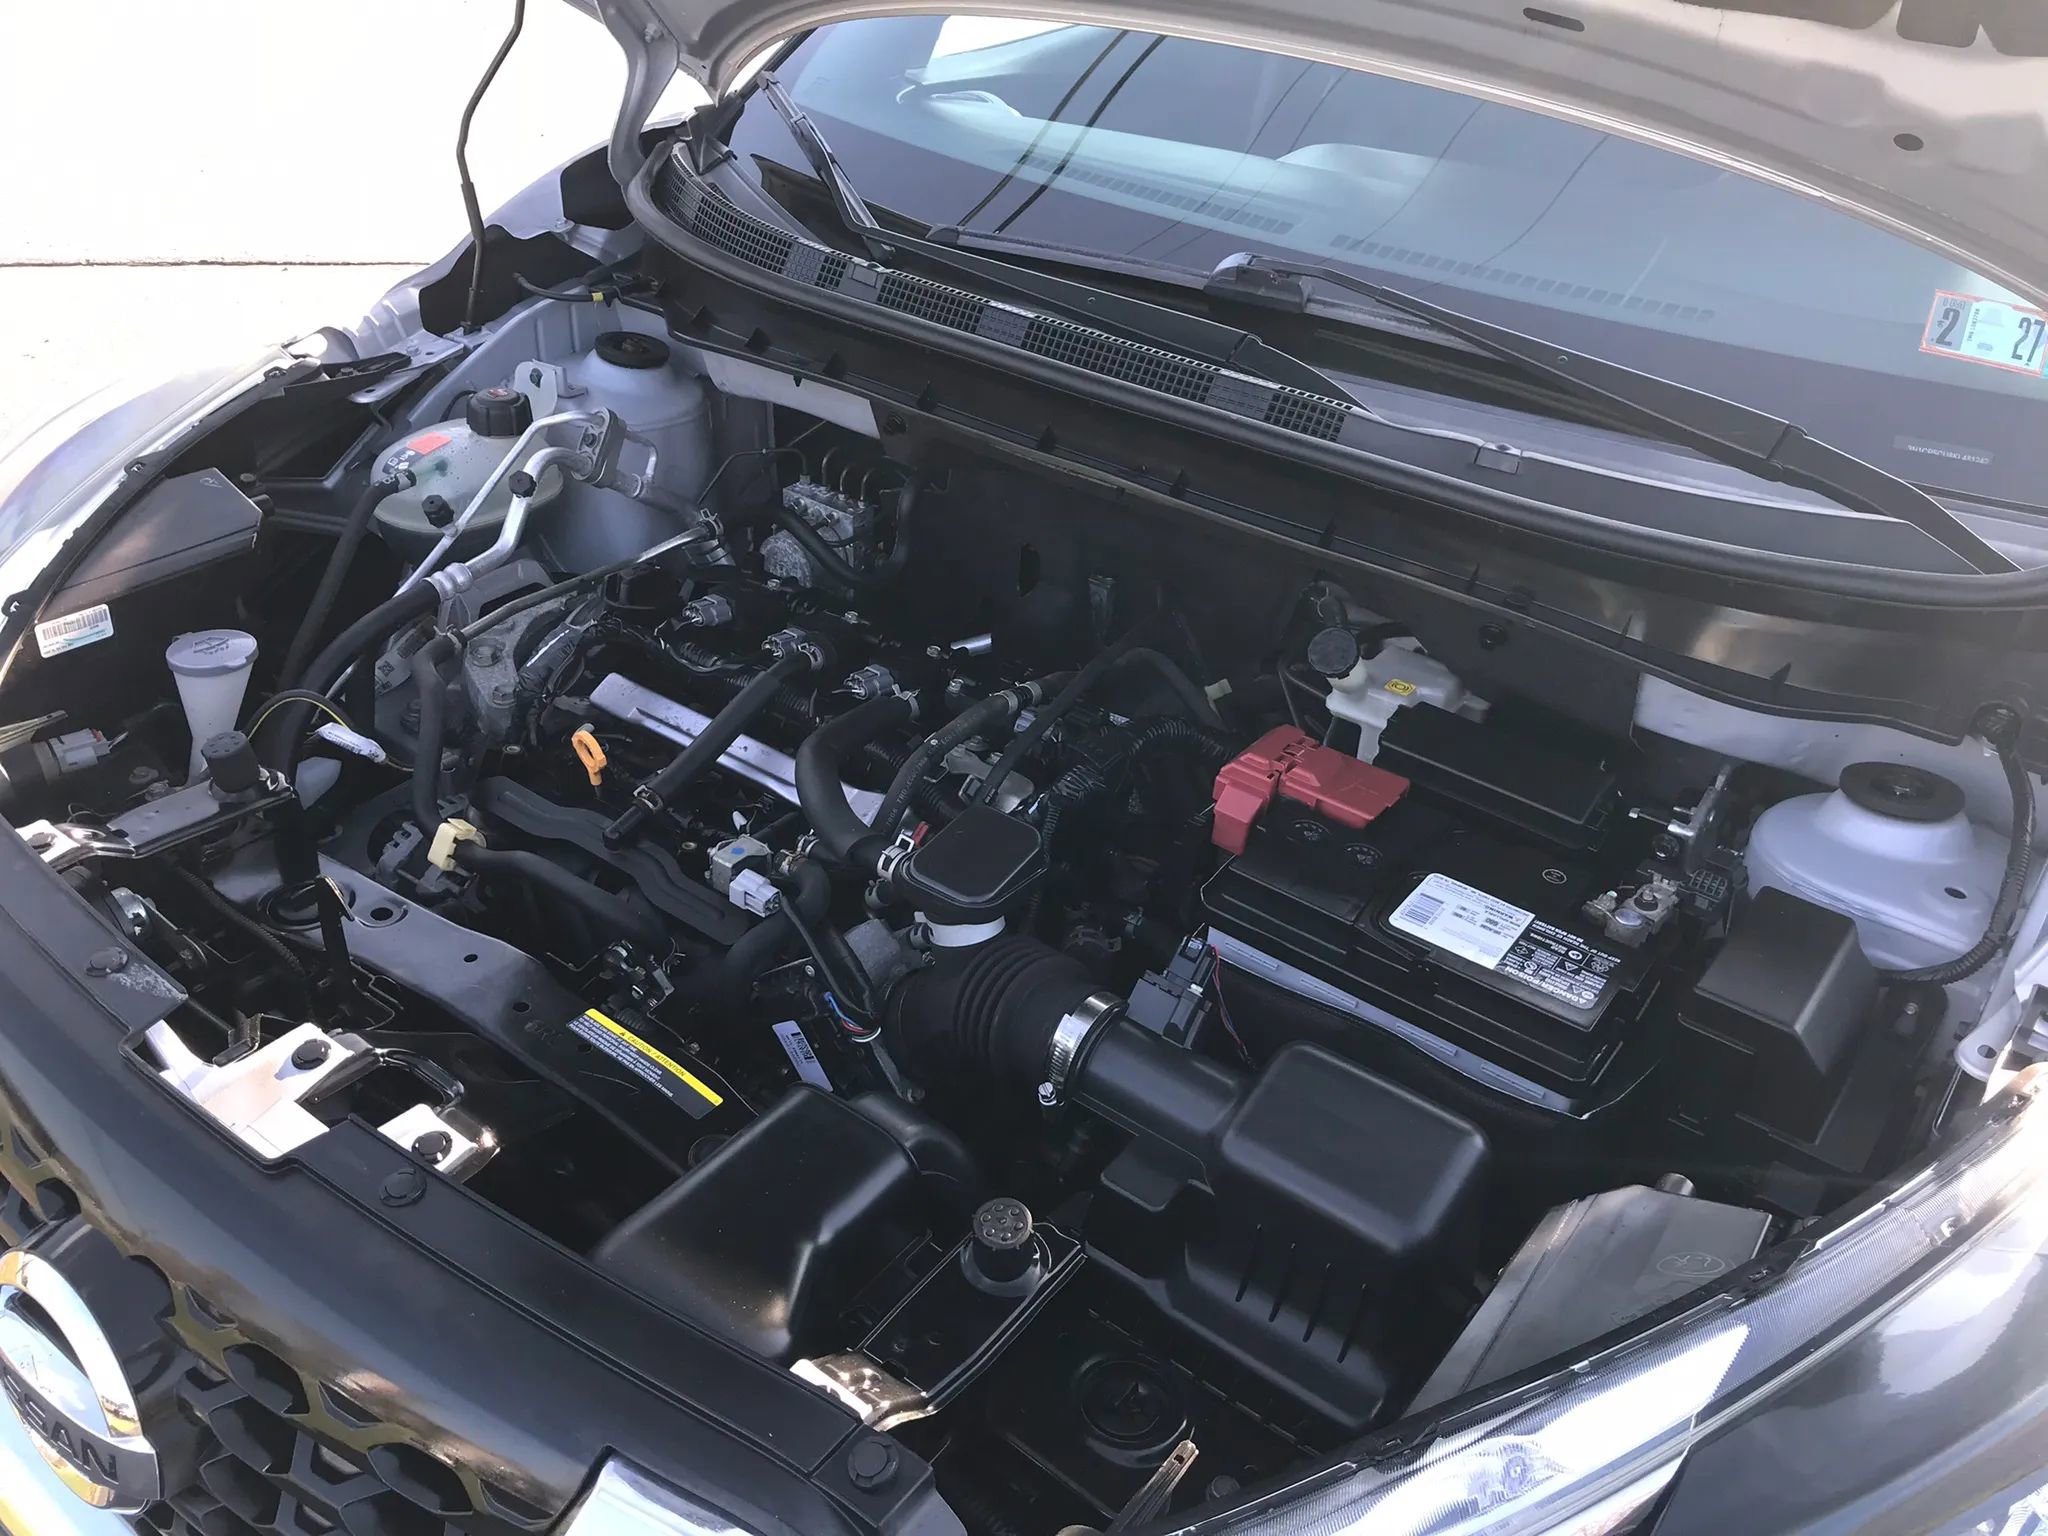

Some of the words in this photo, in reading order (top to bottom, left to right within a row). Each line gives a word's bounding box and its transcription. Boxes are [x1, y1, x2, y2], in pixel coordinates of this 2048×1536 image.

[1936, 308, 1960, 346] 2
[2011, 317, 2045, 363] 27
[627, 1035, 652, 1054] CAUTION
[655, 1053, 686, 1077] ATTENTION
[2, 1366, 119, 1485] SSAN
